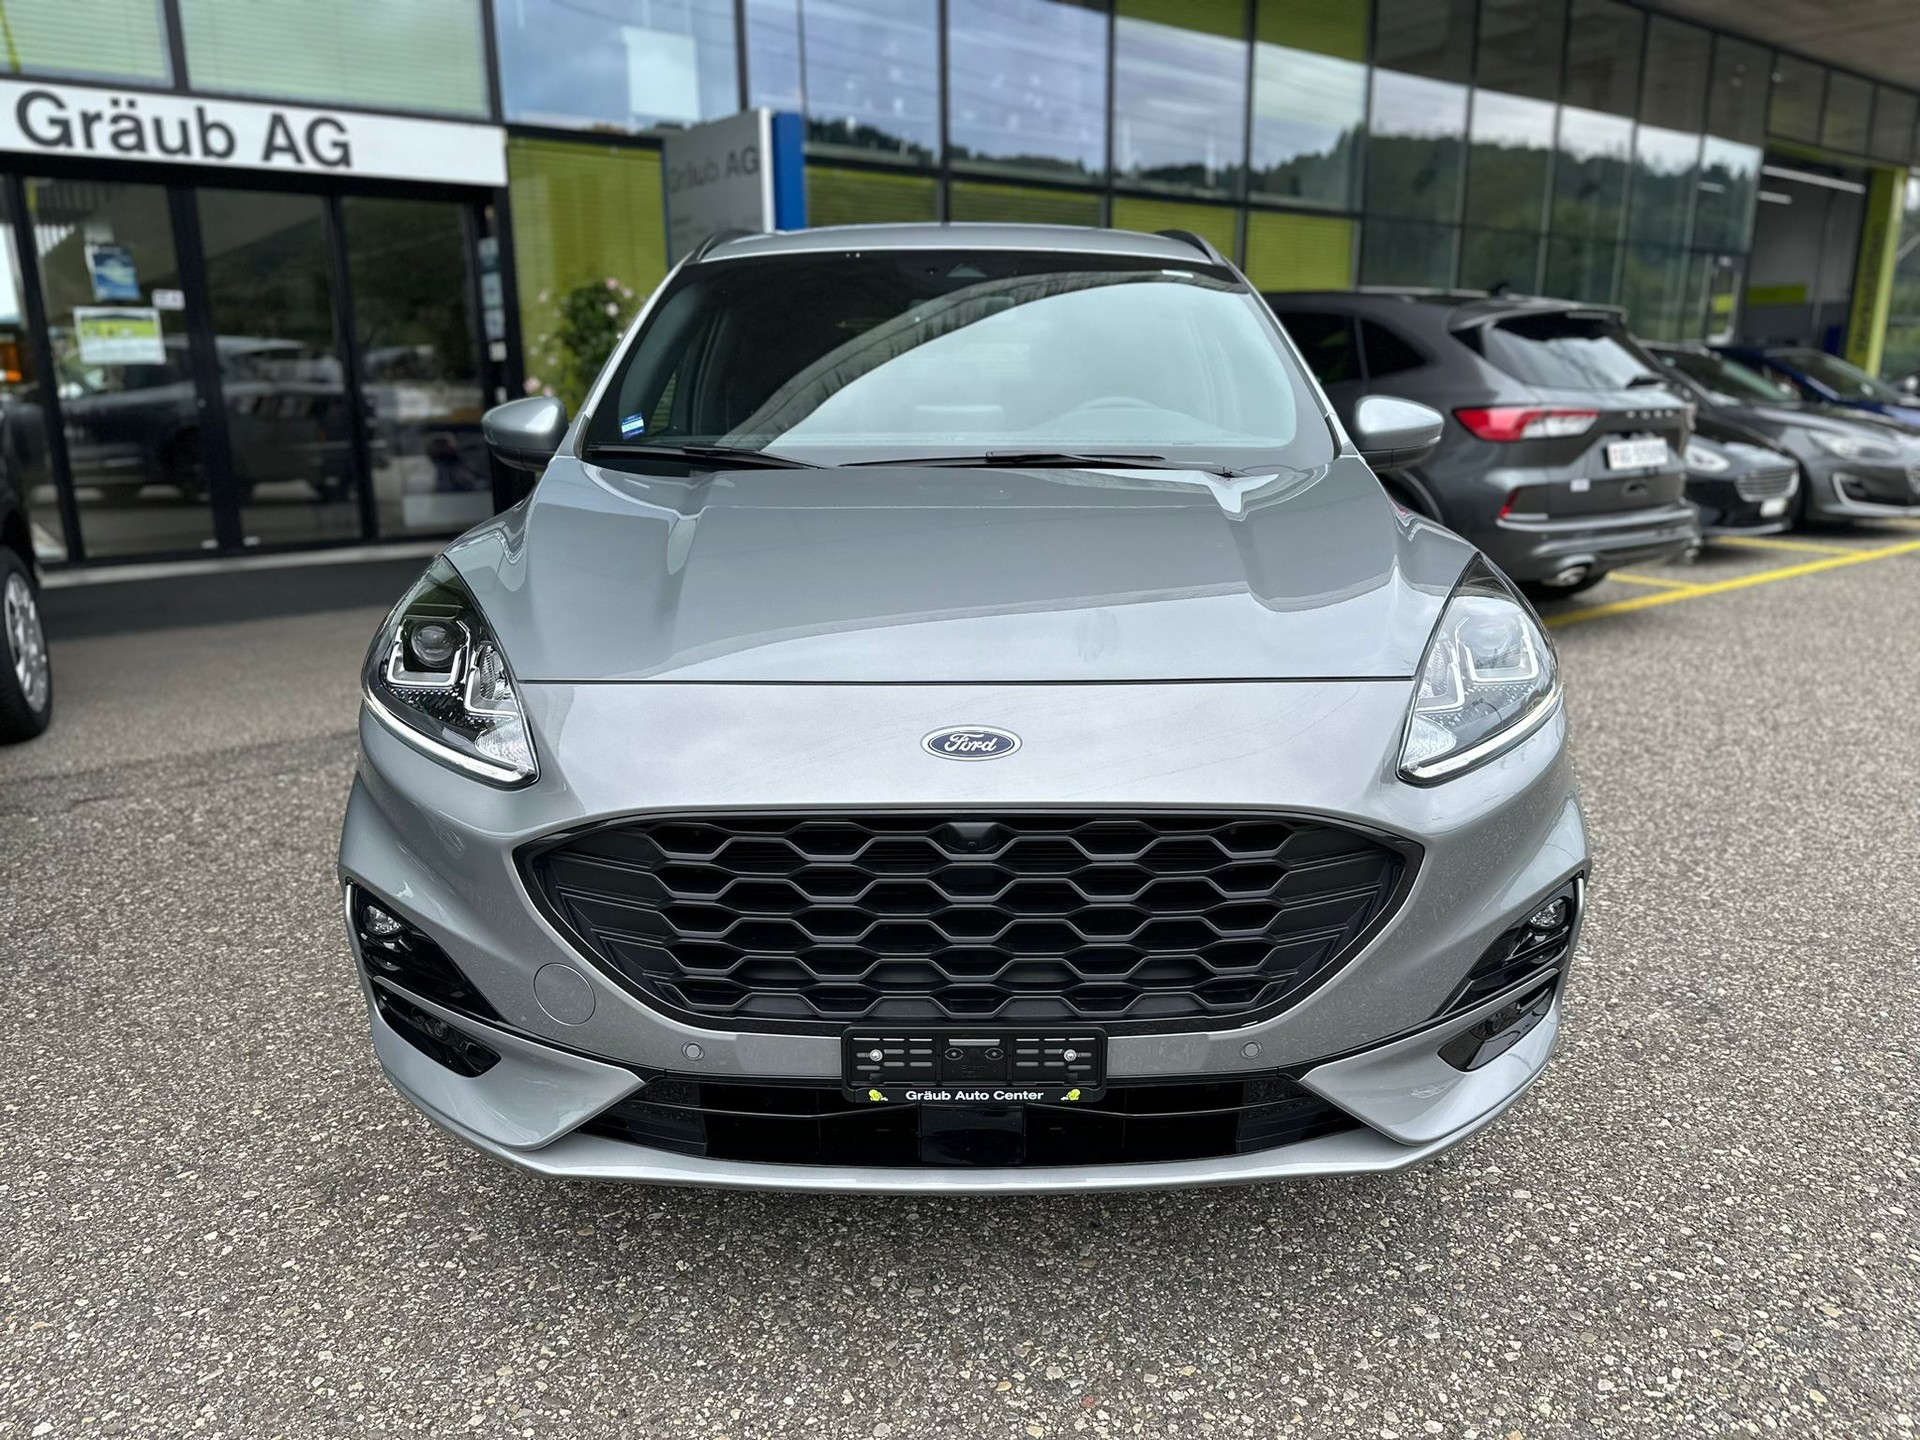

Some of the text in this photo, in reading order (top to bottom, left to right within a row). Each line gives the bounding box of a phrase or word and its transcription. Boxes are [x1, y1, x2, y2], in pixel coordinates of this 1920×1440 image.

[16, 89, 354, 168] Gräub AG
[725, 146, 760, 178] AG
[944, 733, 997, 751] Ford
[905, 1090, 1044, 1101] Gräub Auto Center
